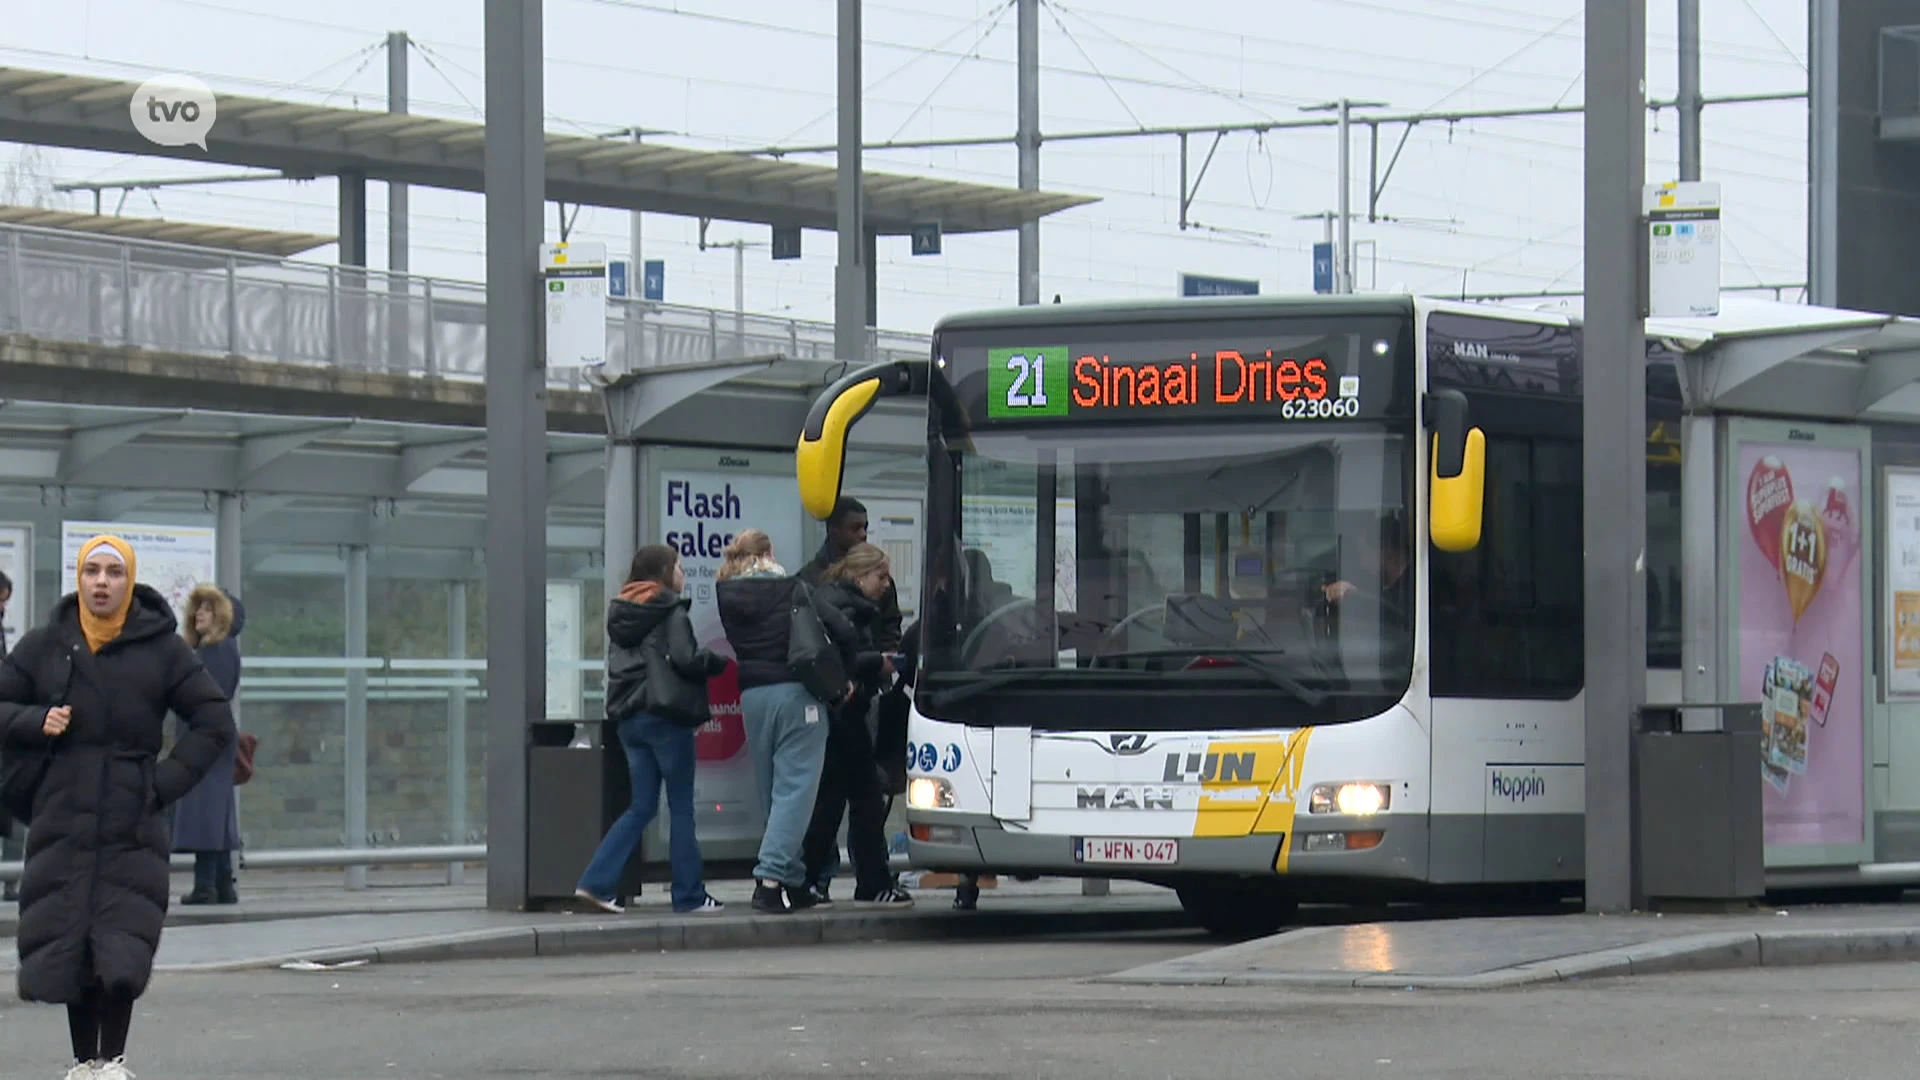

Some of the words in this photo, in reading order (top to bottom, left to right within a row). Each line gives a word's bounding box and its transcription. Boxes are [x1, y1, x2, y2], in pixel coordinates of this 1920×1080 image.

[1454, 341, 1488, 358] MAN
[1006, 354, 1046, 406] 21
[1073, 353, 1197, 407] Sinaai
[1215, 350, 1327, 402] Dries
[1281, 398, 1359, 419] 623060
[667, 480, 741, 519] Flash
